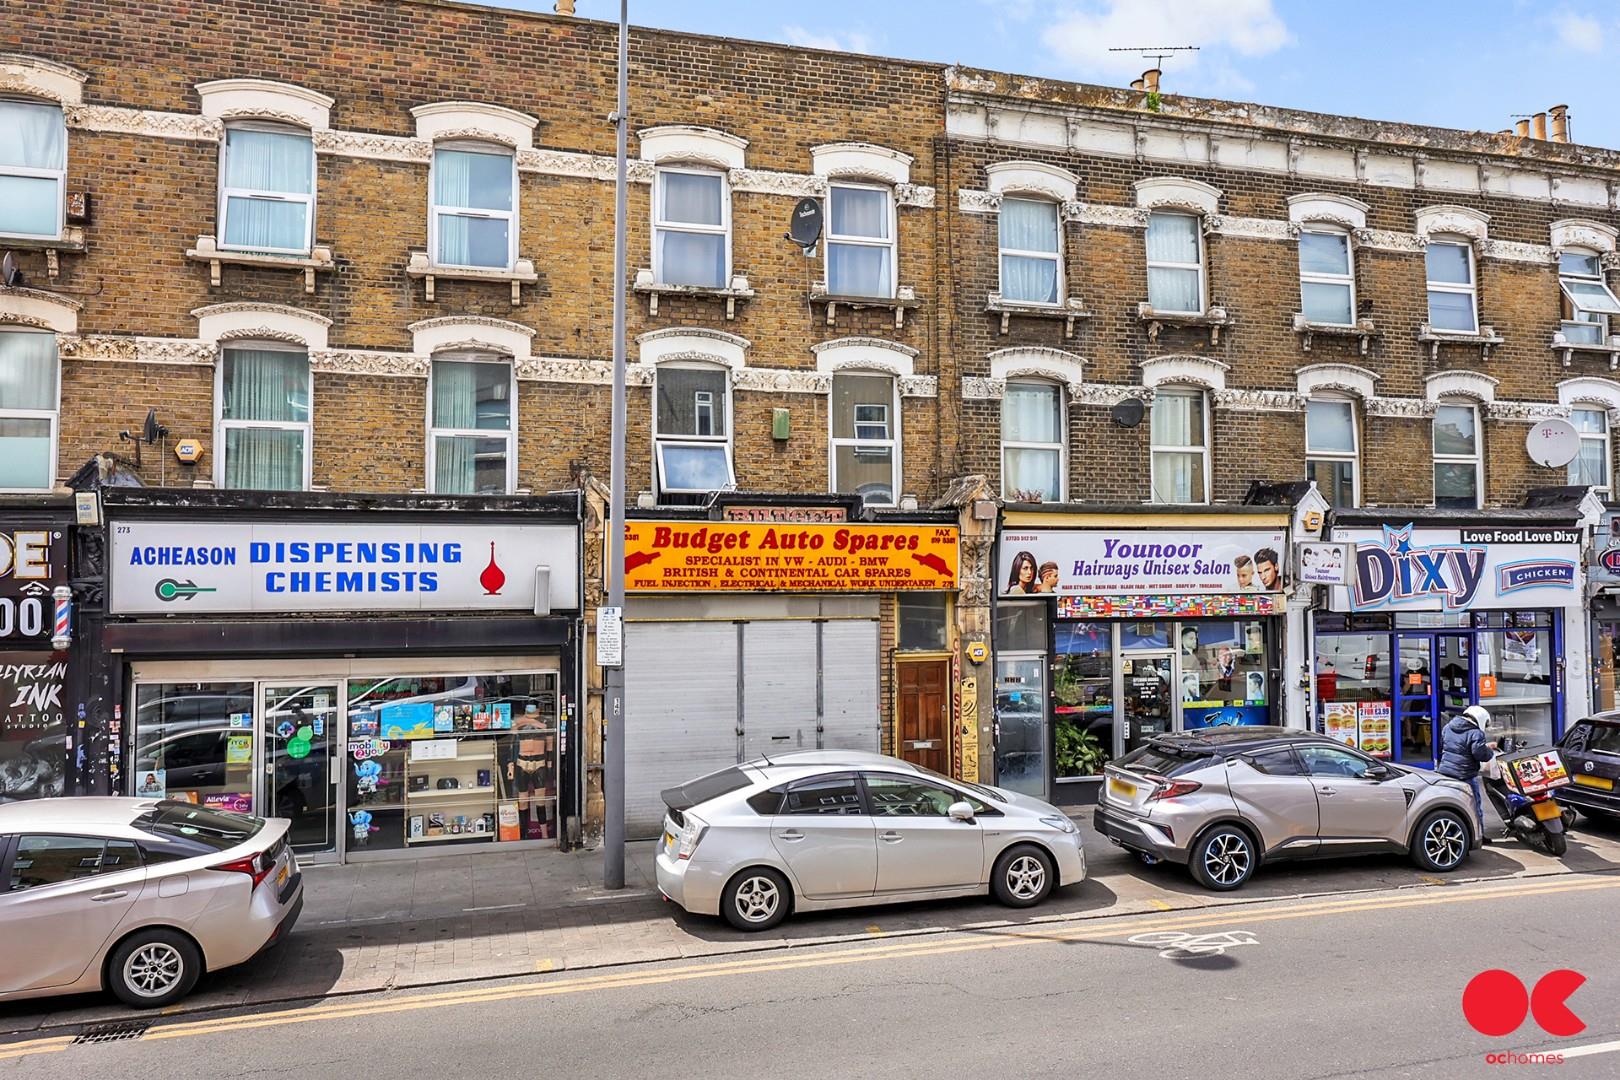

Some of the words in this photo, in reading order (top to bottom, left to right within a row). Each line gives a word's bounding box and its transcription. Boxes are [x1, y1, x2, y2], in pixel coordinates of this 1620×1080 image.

[117, 526, 131, 534] 273
[652, 526, 751, 554] Budget
[758, 528, 824, 549] Auto
[833, 529, 919, 554] Spares
[1463, 531, 1492, 542] Love
[1494, 531, 1522, 542] Food
[1525, 531, 1553, 542] Love
[1554, 531, 1578, 543] Dixy
[130, 547, 236, 565] ACHEASON
[250, 542, 462, 563] DISPENSING
[1103, 539, 1202, 558] Younoor
[685, 556, 761, 566] SPECIALIST
[765, 557, 779, 566] IN
[784, 557, 804, 566] VW
[817, 557, 847, 566] AUDI
[859, 557, 888, 566] BMW
[663, 568, 718, 577] BRITISH
[725, 568, 734, 577] &
[740, 568, 828, 577] CONTINENTAL
[834, 568, 859, 577] CAR
[865, 568, 911, 577] SPARES
[1072, 560, 1139, 580] Hairways
[1143, 559, 1189, 575] Unisex
[1193, 560, 1230, 575] Salon
[1356, 540, 1486, 606] Dixy
[1516, 569, 1567, 581] CHICKEN
[266, 572, 438, 592] CHEMISTS
[720, 580, 776, 588] ELECTRICAL
[9, 682, 63, 712] INK
[349, 741, 389, 750] mobility
[1543, 756, 1557, 767] L
